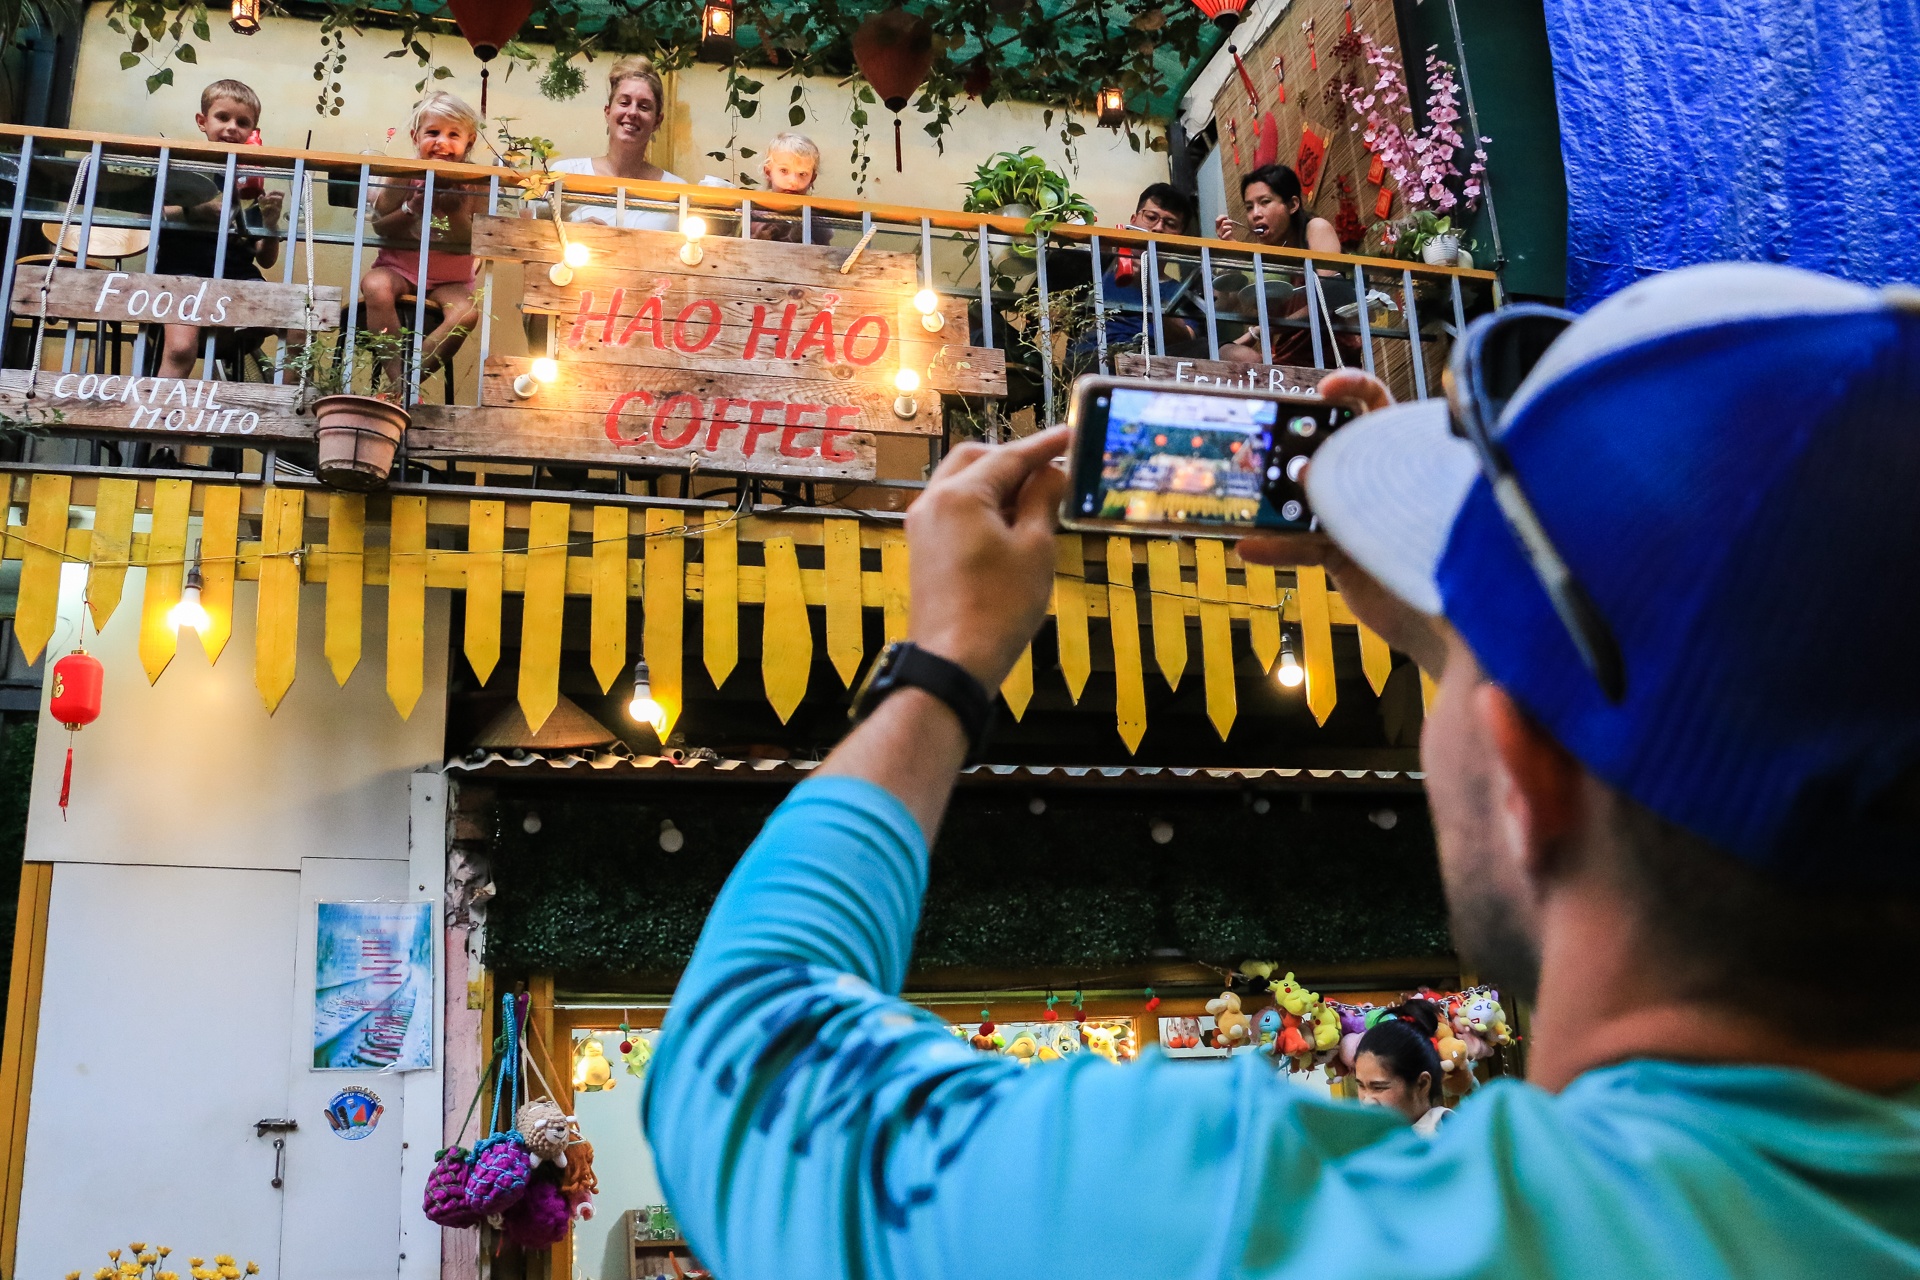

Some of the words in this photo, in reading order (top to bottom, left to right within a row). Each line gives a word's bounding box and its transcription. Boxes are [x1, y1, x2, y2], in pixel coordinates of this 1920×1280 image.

[94, 272, 232, 323] Foods
[54, 373, 220, 410] COCKTAIL
[129, 405, 260, 434] MOJITO
[604, 390, 861, 463] COFFEE
